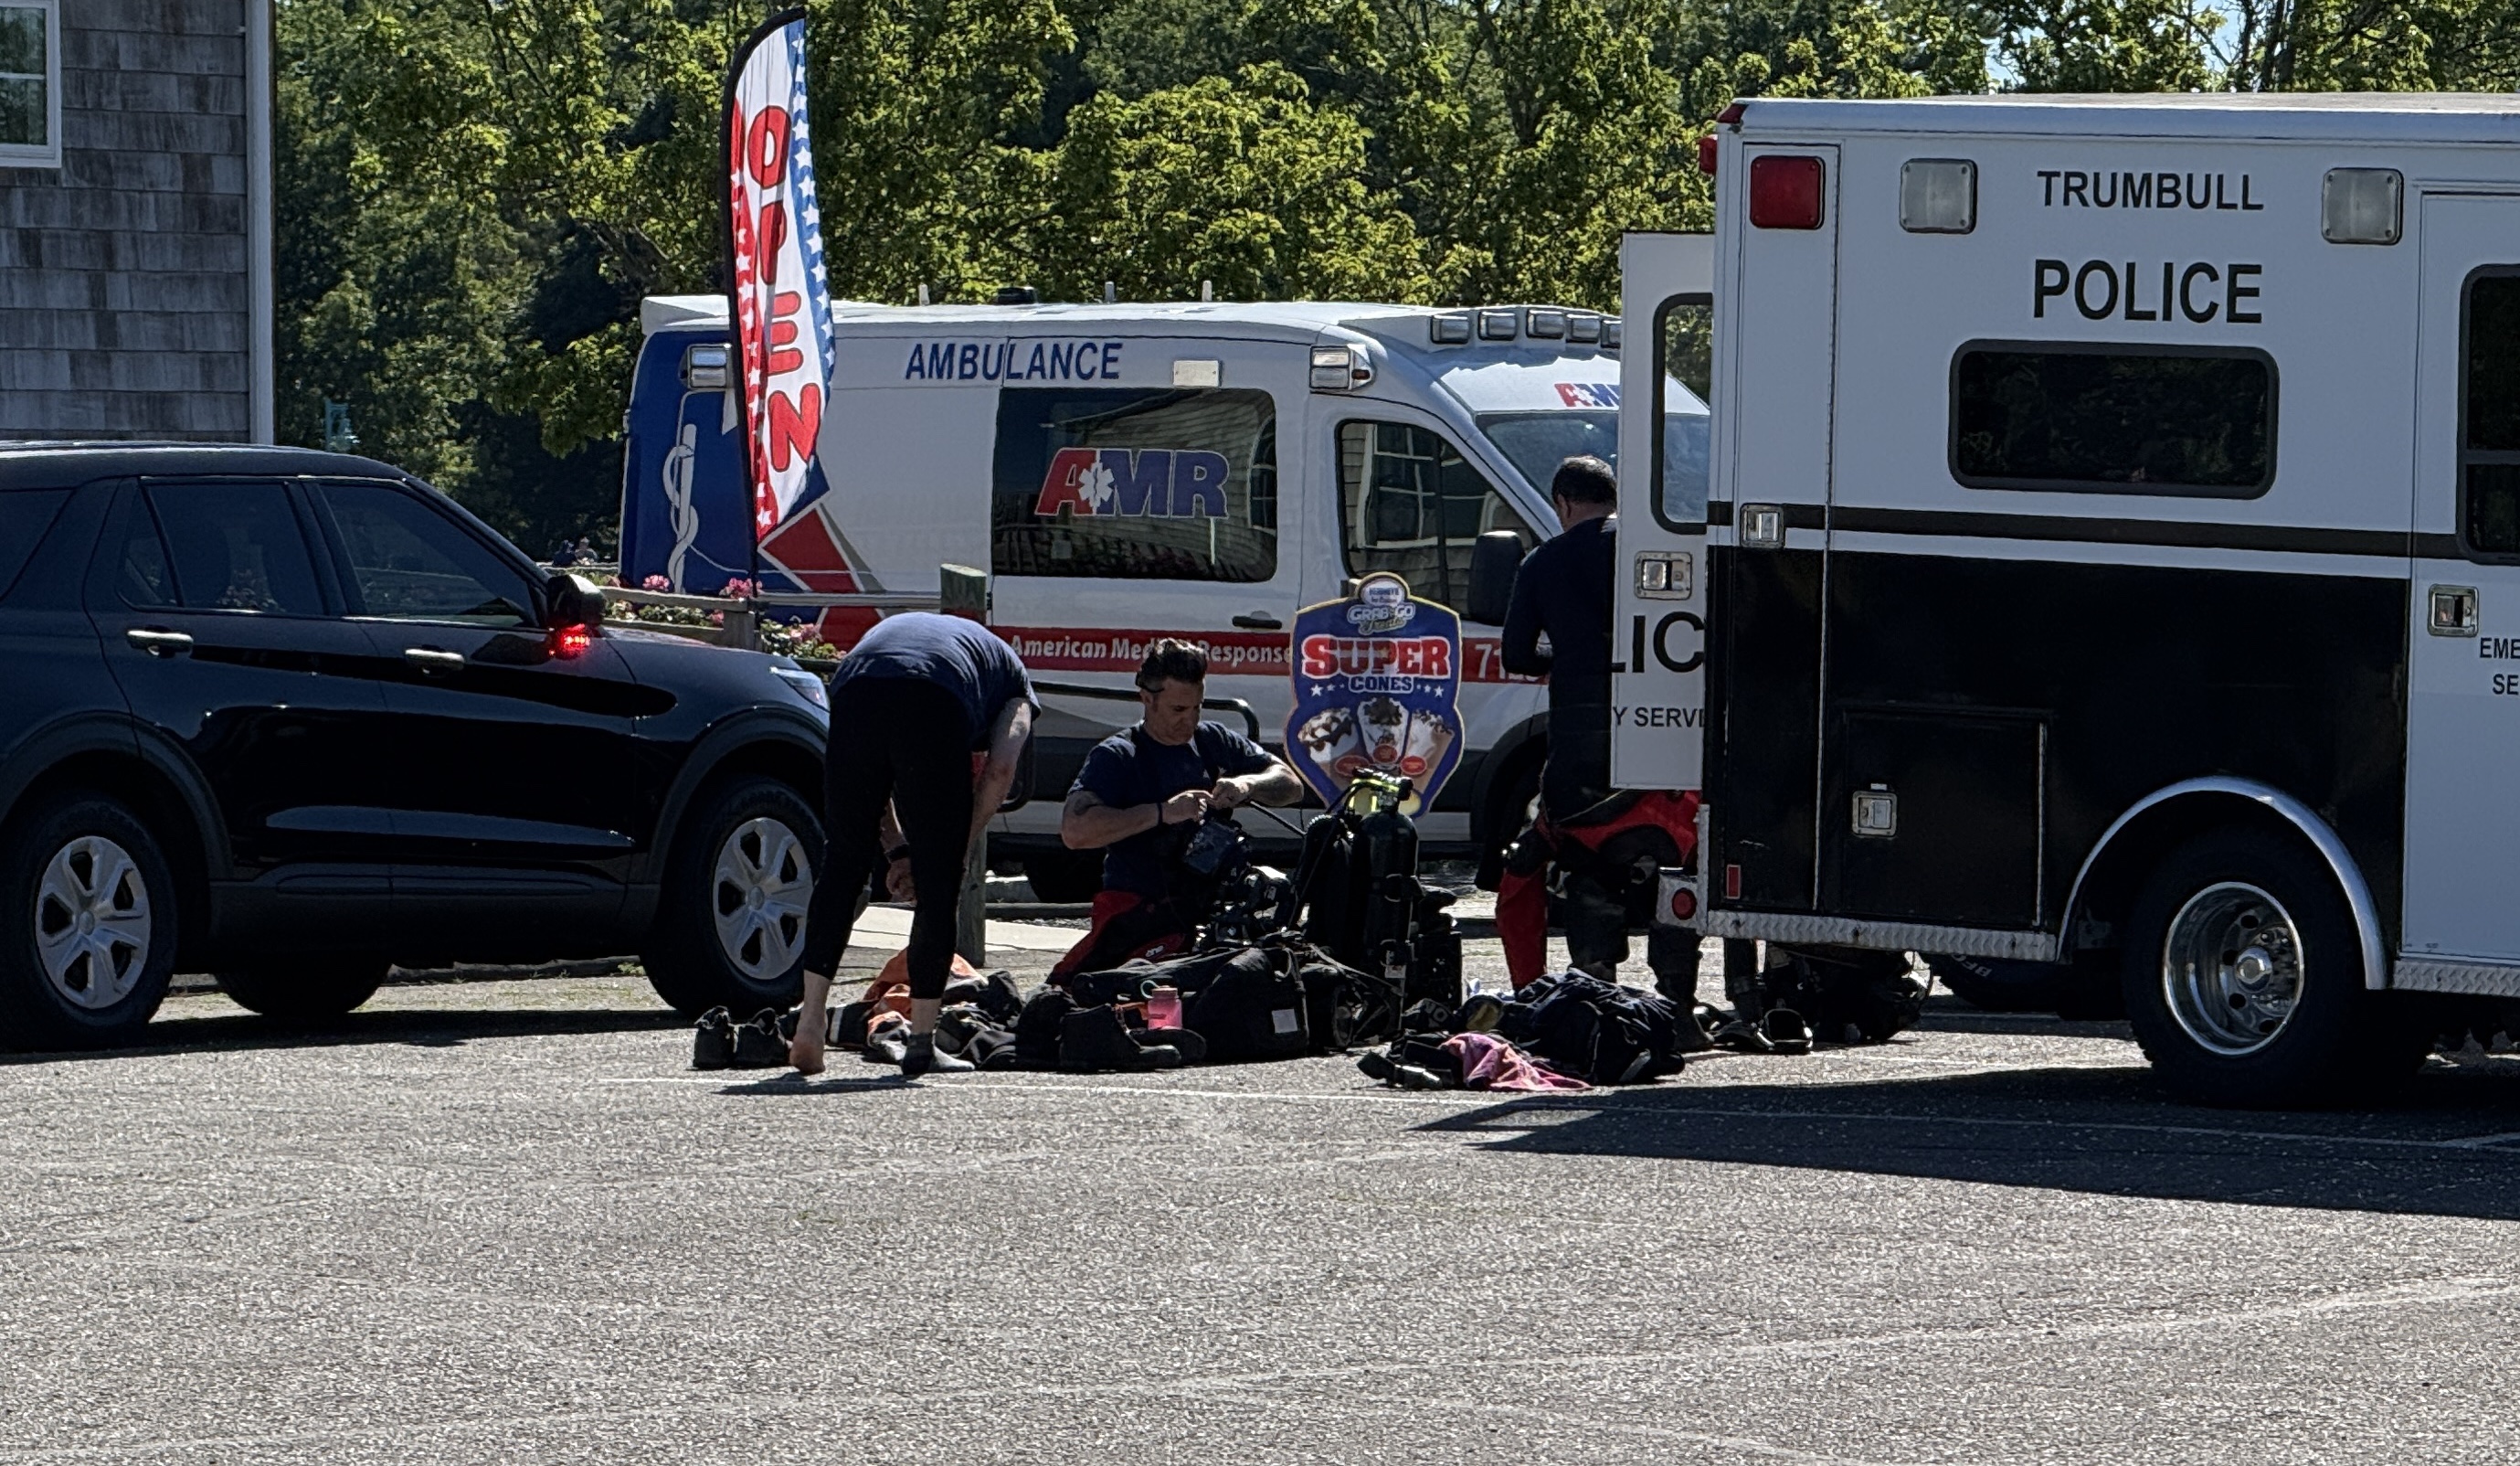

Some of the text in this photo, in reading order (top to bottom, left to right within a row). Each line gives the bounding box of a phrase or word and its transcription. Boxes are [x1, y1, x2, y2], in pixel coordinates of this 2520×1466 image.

[2037, 170, 2264, 211] TRUMBULL
[747, 104, 821, 473] OPEN
[2033, 259, 2262, 324] POLICE
[905, 342, 1124, 381] AMBULANCE
[1034, 447, 1230, 519] AMR
[1011, 635, 1107, 659] American
[1303, 635, 1450, 679] SUPER
[1350, 675, 1413, 692] CONES
[2493, 674, 2519, 696] SE
